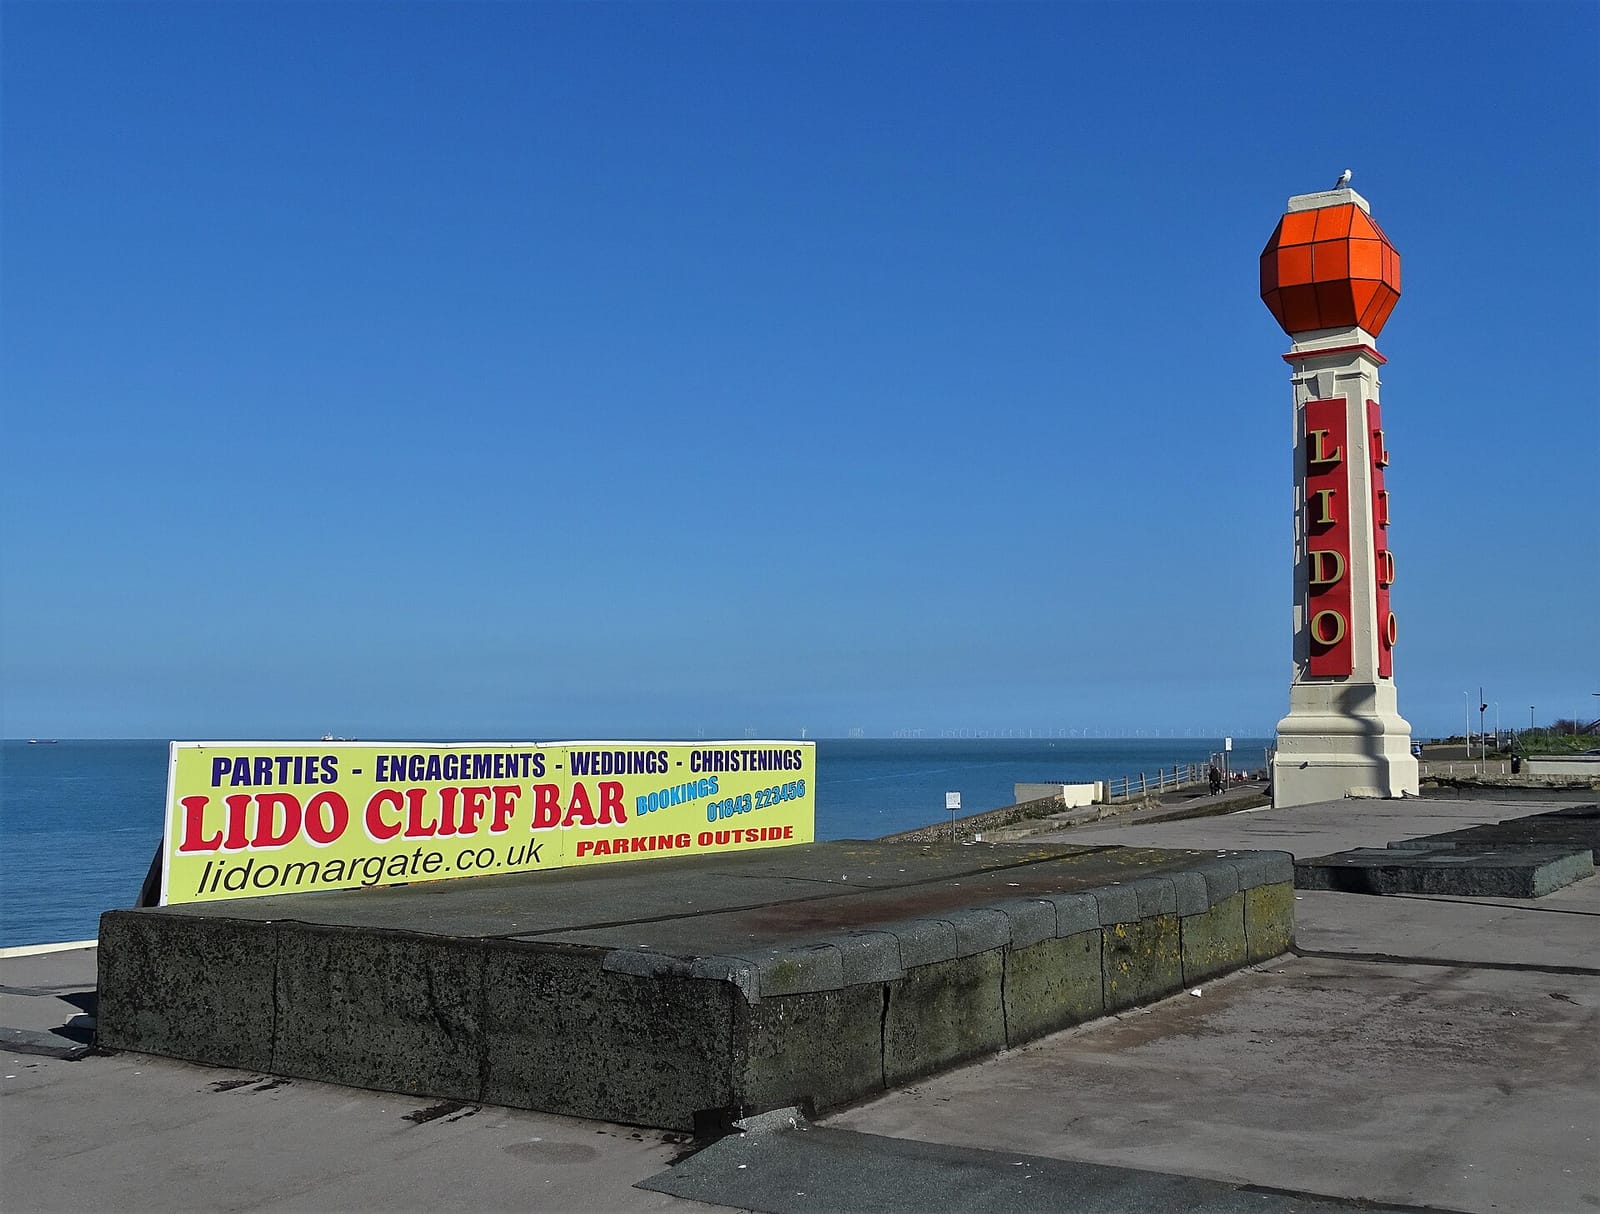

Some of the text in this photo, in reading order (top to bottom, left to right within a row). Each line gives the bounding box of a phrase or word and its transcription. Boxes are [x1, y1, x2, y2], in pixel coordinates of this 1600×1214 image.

[1309, 429, 1347, 646] LIDO
[211, 755, 338, 787] PARTIES
[375, 753, 546, 782] ENGAGEMENTS
[570, 750, 669, 776] WEDDINGS
[690, 749, 802, 773] CHRISTENINGS
[178, 781, 628, 854] LIDO CLIFF BAR
[636, 776, 719, 816] BOOKINGS
[707, 779, 806, 823] 01843 223456
[576, 826, 794, 857] PARKING OUTSIDE
[197, 838, 544, 894] lidomargate.co.uk
